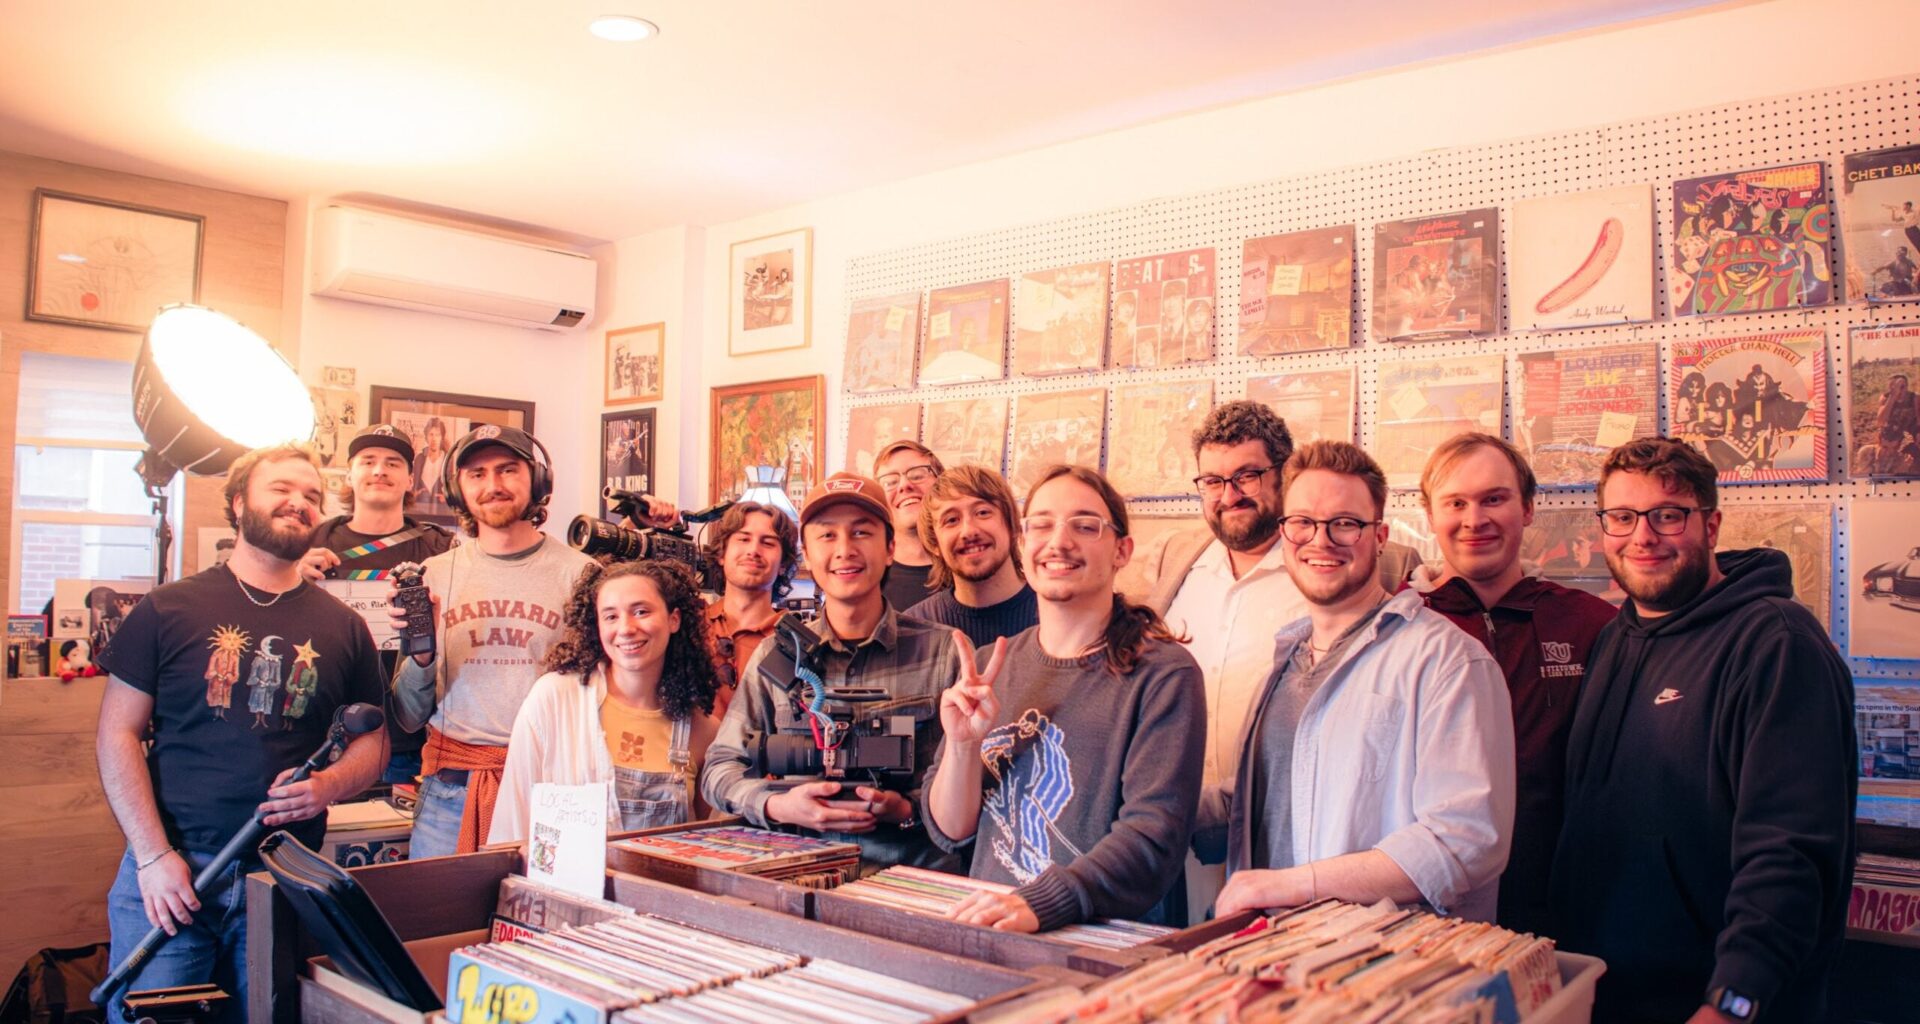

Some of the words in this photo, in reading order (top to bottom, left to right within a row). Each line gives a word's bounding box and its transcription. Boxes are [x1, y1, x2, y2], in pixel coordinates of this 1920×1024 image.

[1848, 166, 1888, 182] CHET
[1857, 331, 1881, 340] THE
[1884, 328, 1920, 338] CLASH
[1773, 347, 1796, 363] HELL
[625, 474, 648, 492] KING
[442, 599, 561, 630] HARVARD
[468, 627, 535, 648] LAW
[1541, 641, 1571, 664] KU
